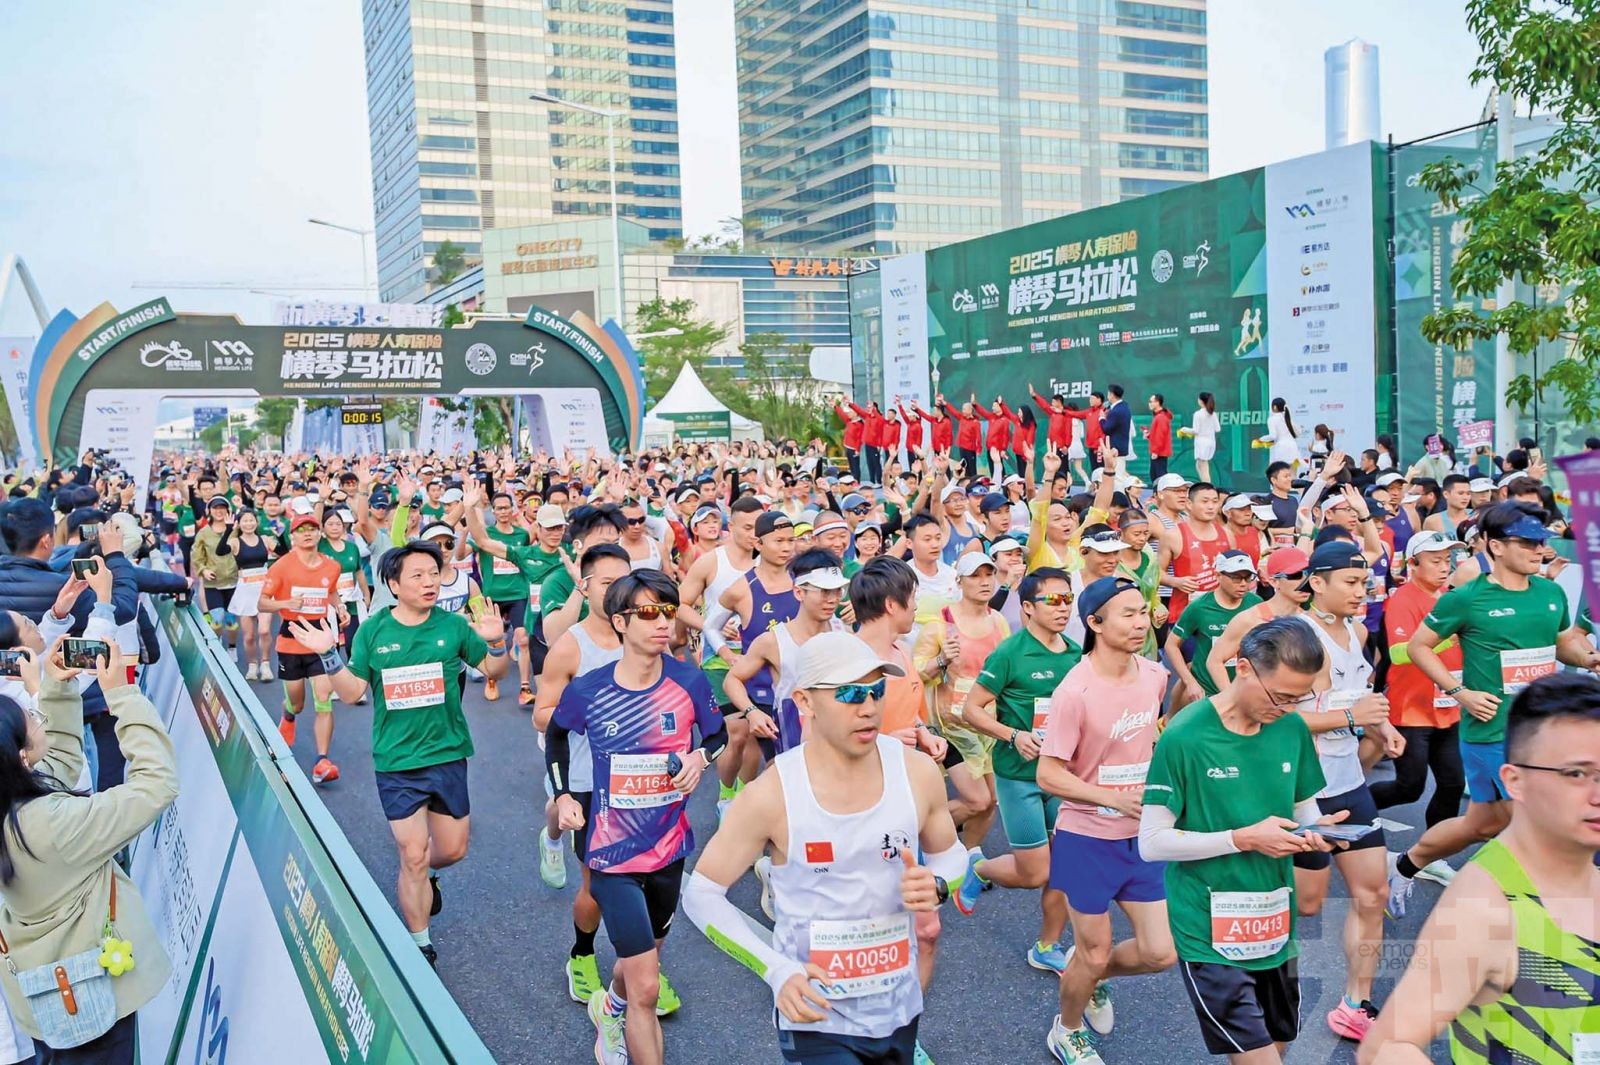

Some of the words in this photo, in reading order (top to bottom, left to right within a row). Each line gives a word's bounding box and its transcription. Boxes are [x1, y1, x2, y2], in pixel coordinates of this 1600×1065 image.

[1010, 249, 1054, 275] 2025
[1055, 230, 1137, 265] 横琴人寿保险
[1008, 256, 1139, 315] 横琴马拉松
[78, 303, 165, 361] START/FINISH
[284, 333, 344, 348] 2025
[347, 333, 443, 349] 横琴人寿保险
[533, 311, 604, 363] START/FINISH
[281, 350, 443, 380] 横琴马拉松
[393, 680, 436, 694] A11634
[623, 776, 674, 790] A1164
[1228, 916, 1282, 935] A10413
[828, 946, 898, 971] A10050
[332, 955, 376, 1063] 横琴马拉松
